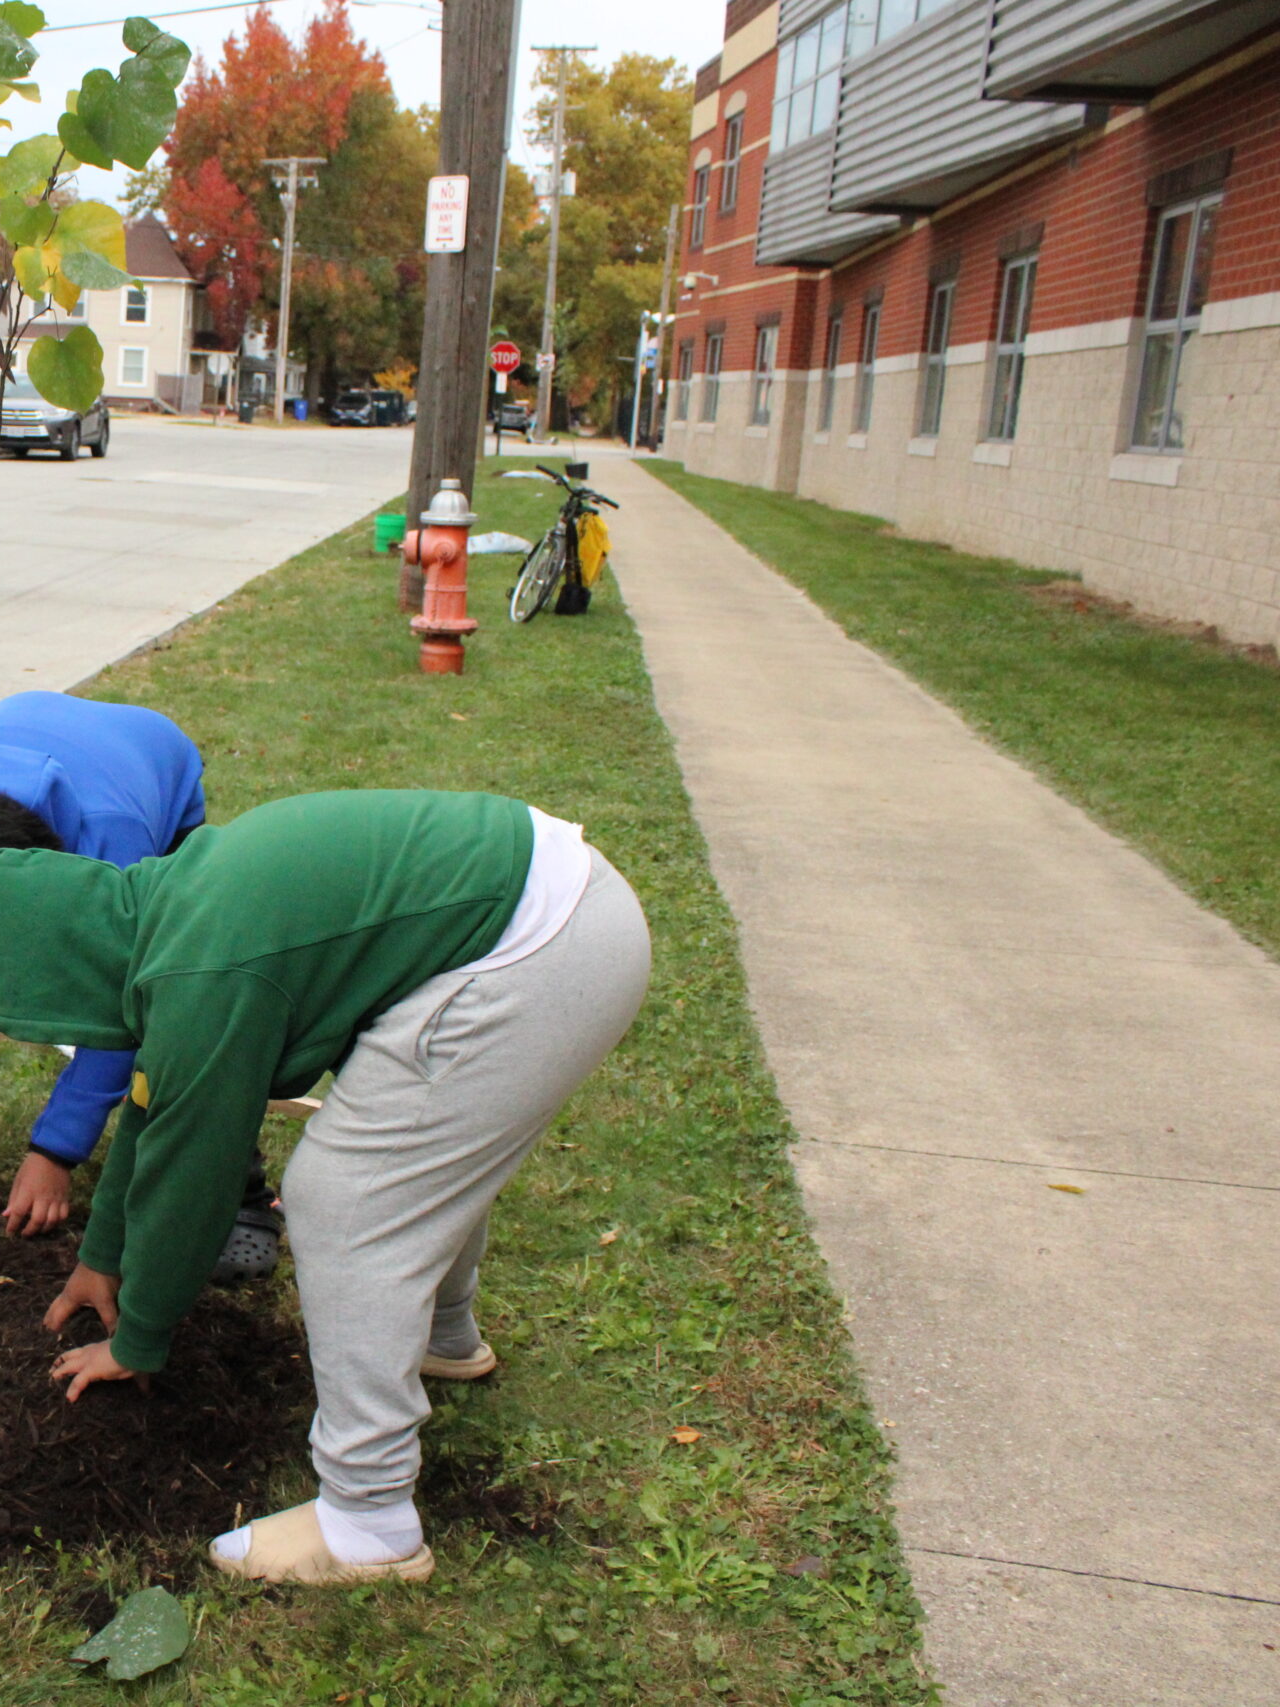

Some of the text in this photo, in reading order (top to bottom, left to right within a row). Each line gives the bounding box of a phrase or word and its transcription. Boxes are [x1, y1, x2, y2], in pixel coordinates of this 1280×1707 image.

[440, 186, 455, 199] NO
[431, 201, 462, 211] PARKING
[439, 214, 453, 222] ANY
[438, 225, 453, 234] TIME
[490, 351, 518, 364] STOP
